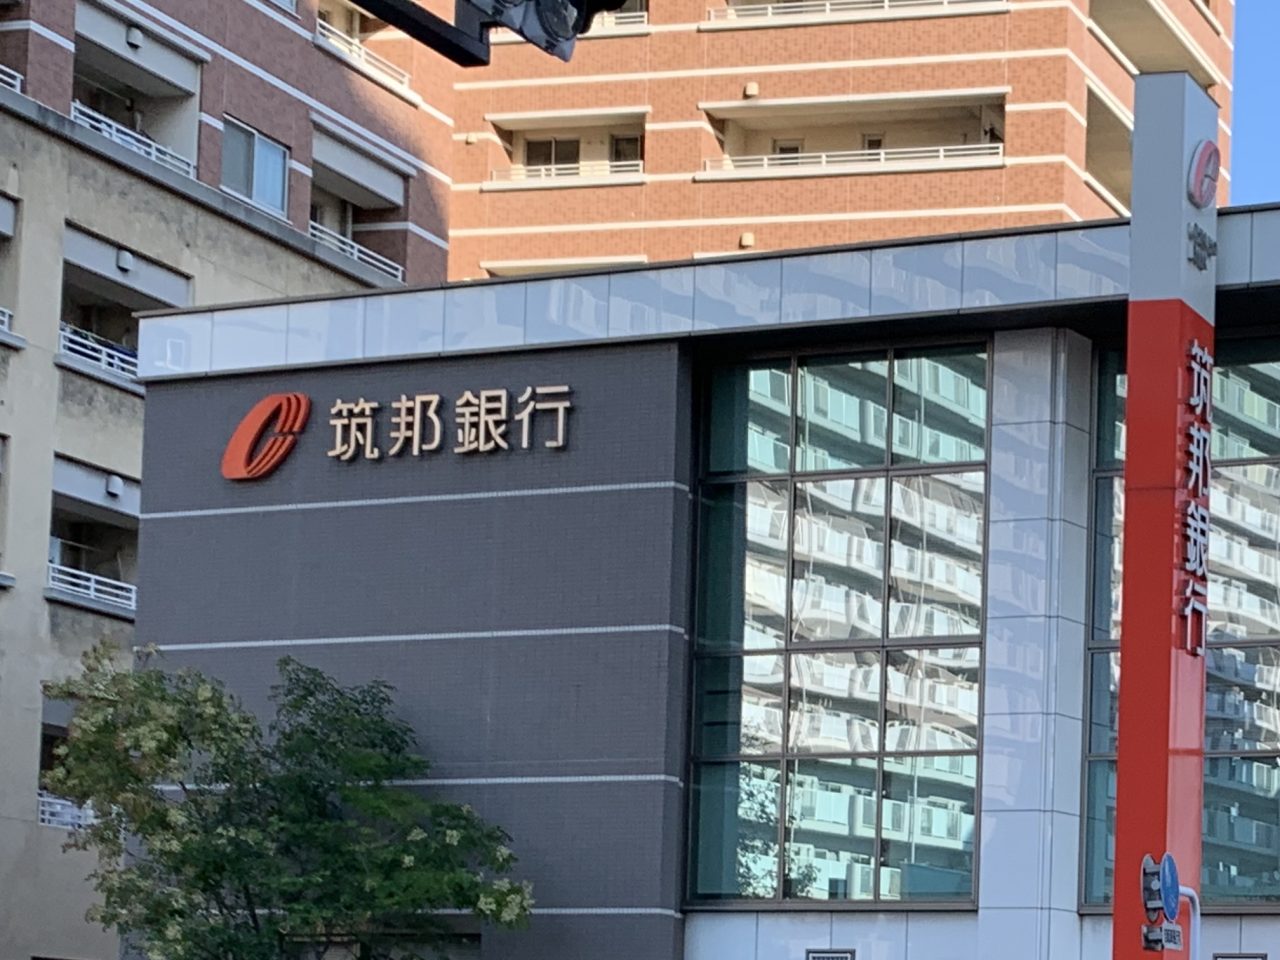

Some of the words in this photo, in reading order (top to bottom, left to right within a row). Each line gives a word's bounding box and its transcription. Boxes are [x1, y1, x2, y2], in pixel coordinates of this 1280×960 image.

[327, 385, 571, 461] 筑邦銀行
[1184, 338, 1214, 657] 筑邦銀行
